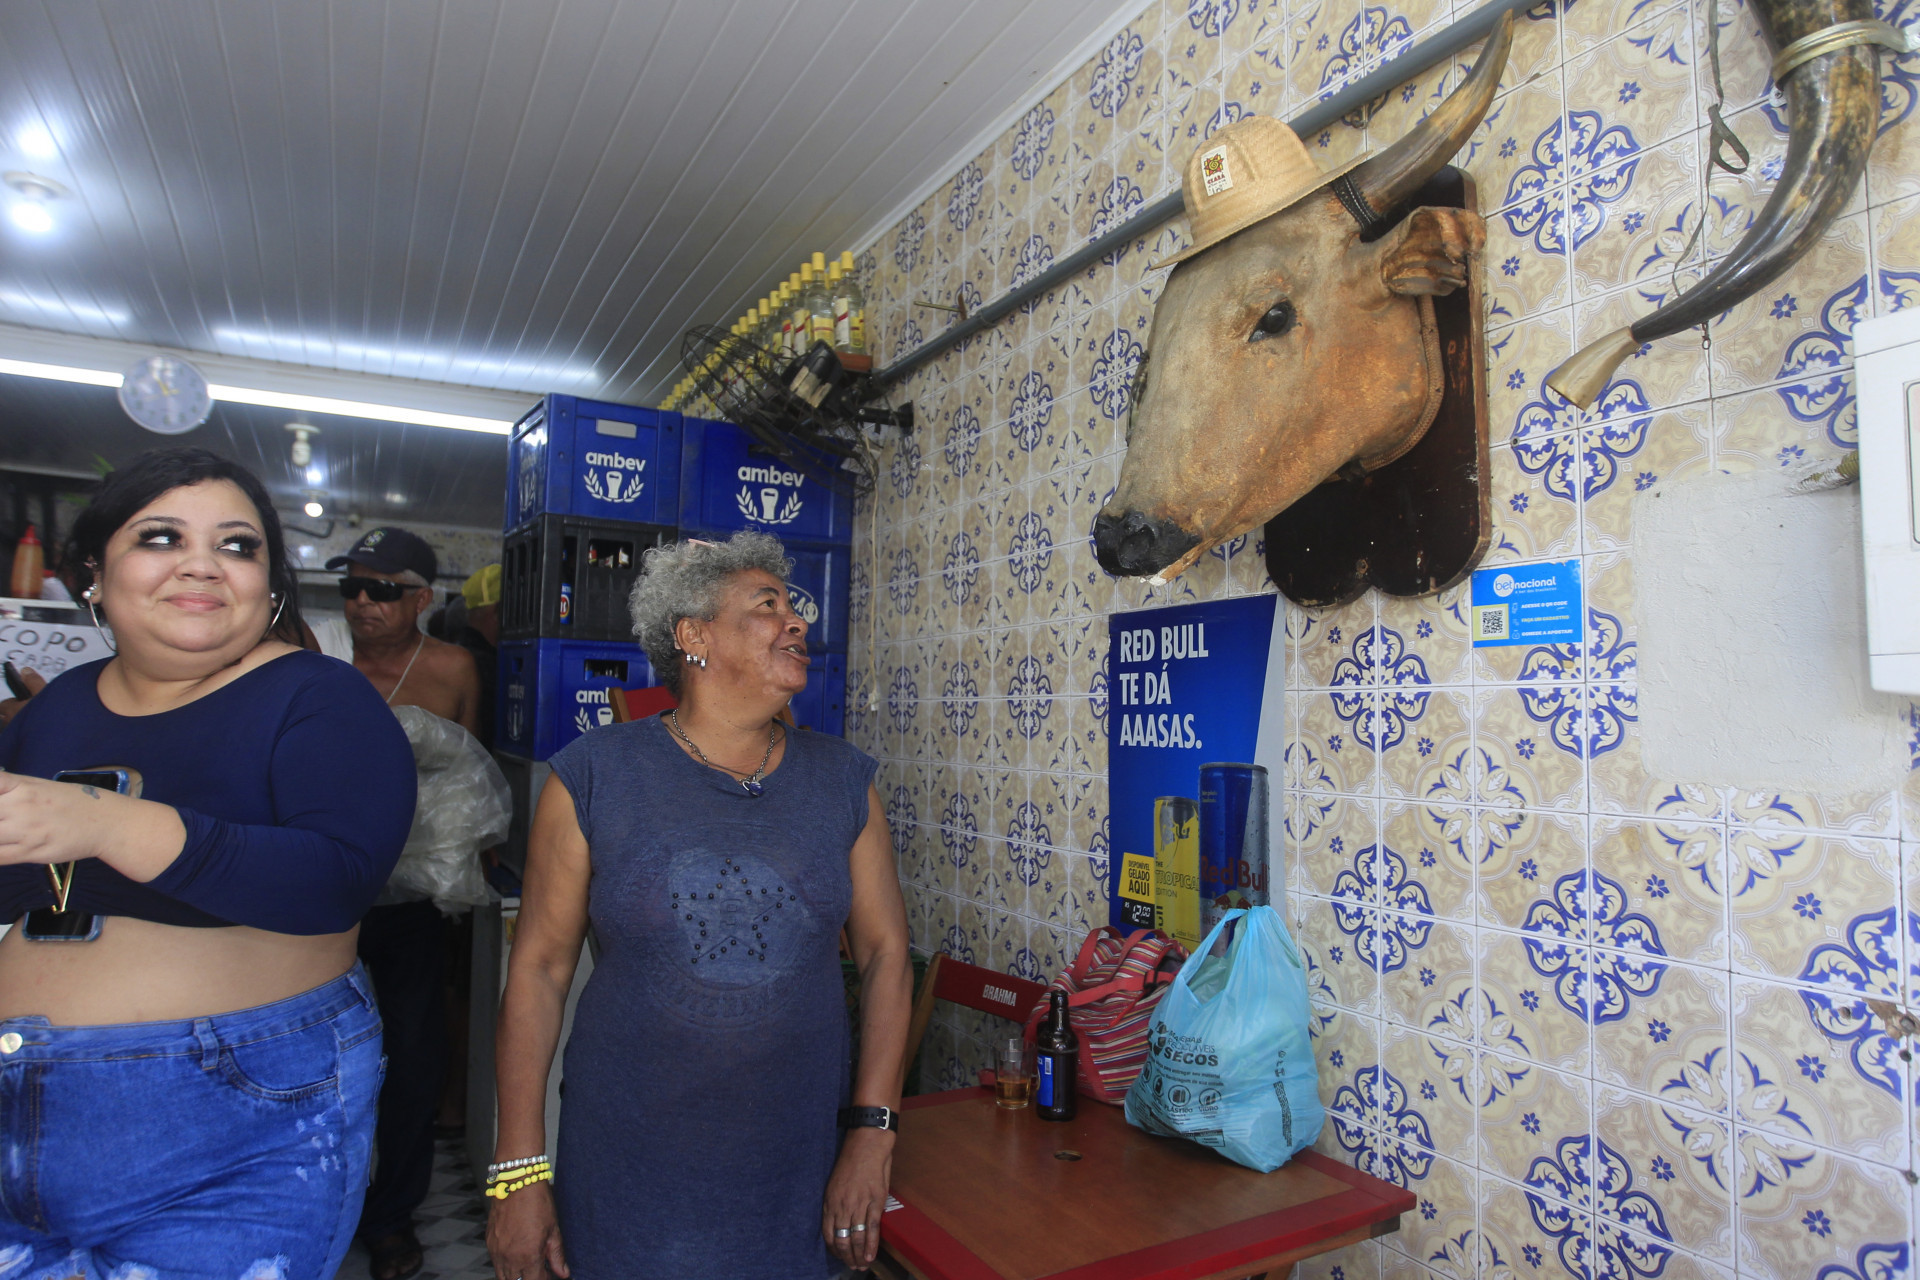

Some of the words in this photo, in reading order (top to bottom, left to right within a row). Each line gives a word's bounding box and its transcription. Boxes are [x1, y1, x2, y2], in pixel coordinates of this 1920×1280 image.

[584, 451, 647, 472] ambev
[737, 465, 805, 487] ambev
[0, 625, 87, 653] COPO
[1120, 628, 1156, 663] RED
[1161, 622, 1209, 661] BULL
[1119, 672, 1139, 706] TE
[1144, 662, 1172, 705] DÁ
[1119, 713, 1203, 750] AAASAS.
[1128, 868, 1150, 881] GELADO
[1201, 855, 1234, 886] Red
[1238, 860, 1268, 893] Bull
[1128, 879, 1150, 897] AQUI
[982, 984, 1017, 1006] BRAHMA
[1164, 1047, 1218, 1067] SECOS
